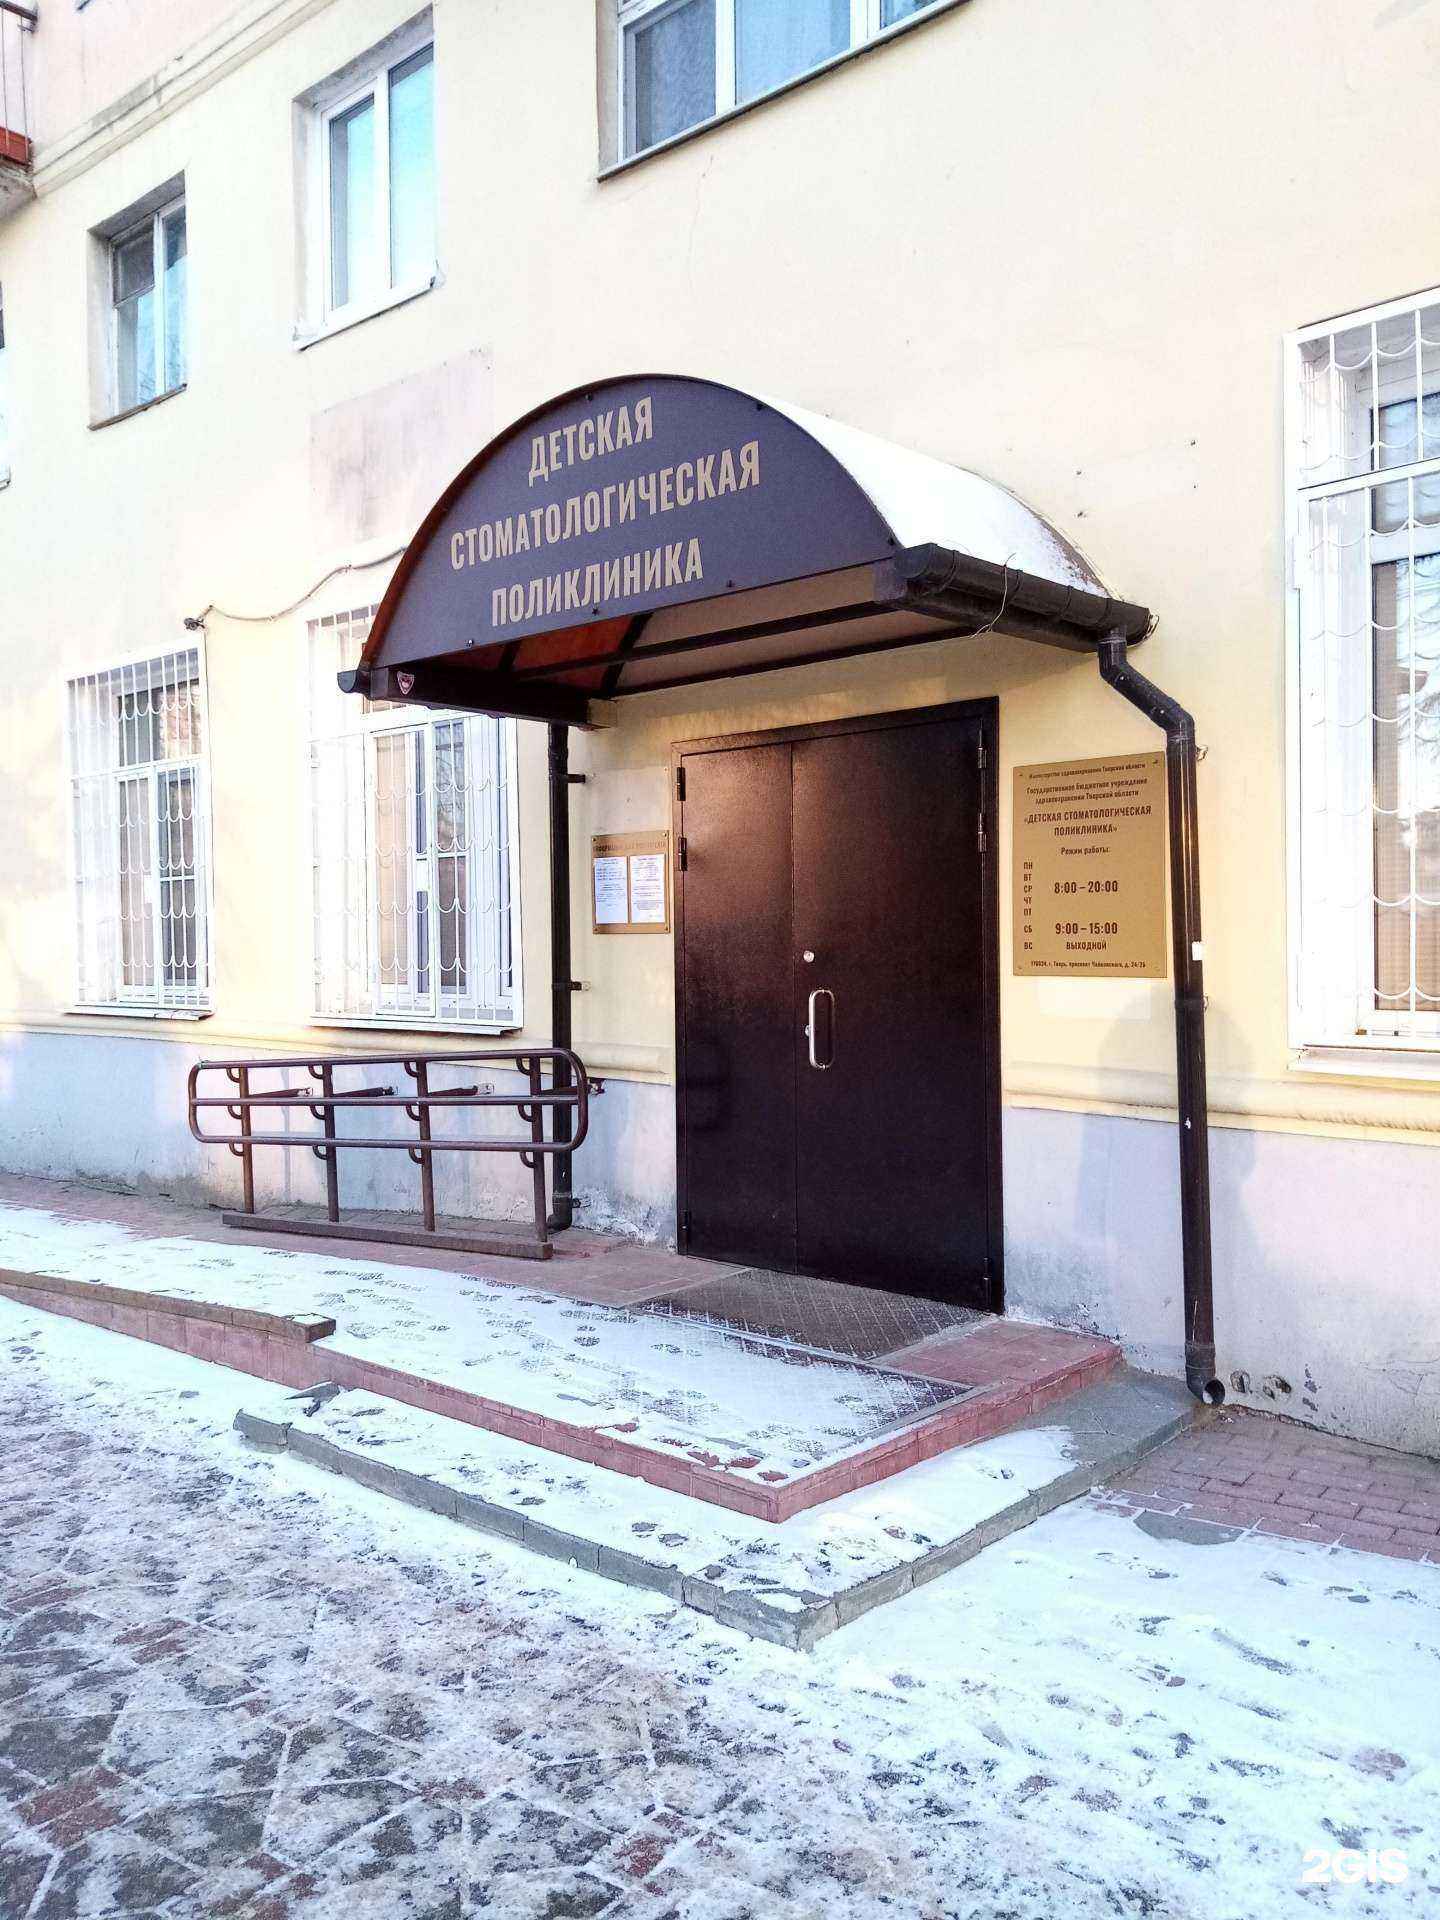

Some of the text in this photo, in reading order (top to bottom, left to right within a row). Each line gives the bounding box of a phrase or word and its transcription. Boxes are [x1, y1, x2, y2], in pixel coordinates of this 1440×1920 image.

[528, 396, 654, 488] ДЕТСКАЯ
[450, 440, 761, 571] СТОМАТОЛОГИЧЕСКАЯ
[491, 537, 704, 627] ПОЛИКЛИНИКА
[1064, 805, 1152, 820] СТОМАТОЛОГИЧЕСКАЯ
[1054, 824, 1118, 836] ПОЛИКЛИНИКА»
[1061, 847, 1083, 855] Режим
[1023, 862, 1033, 870] ПН
[1023, 885, 1033, 893] СР
[1023, 897, 1033, 905] ЧТ
[1023, 908, 1033, 916] ПТ
[1023, 925, 1033, 933] СБ
[1023, 942, 1033, 950] ВС
[1066, 940, 1107, 950] ВЫХОДНОЙ
